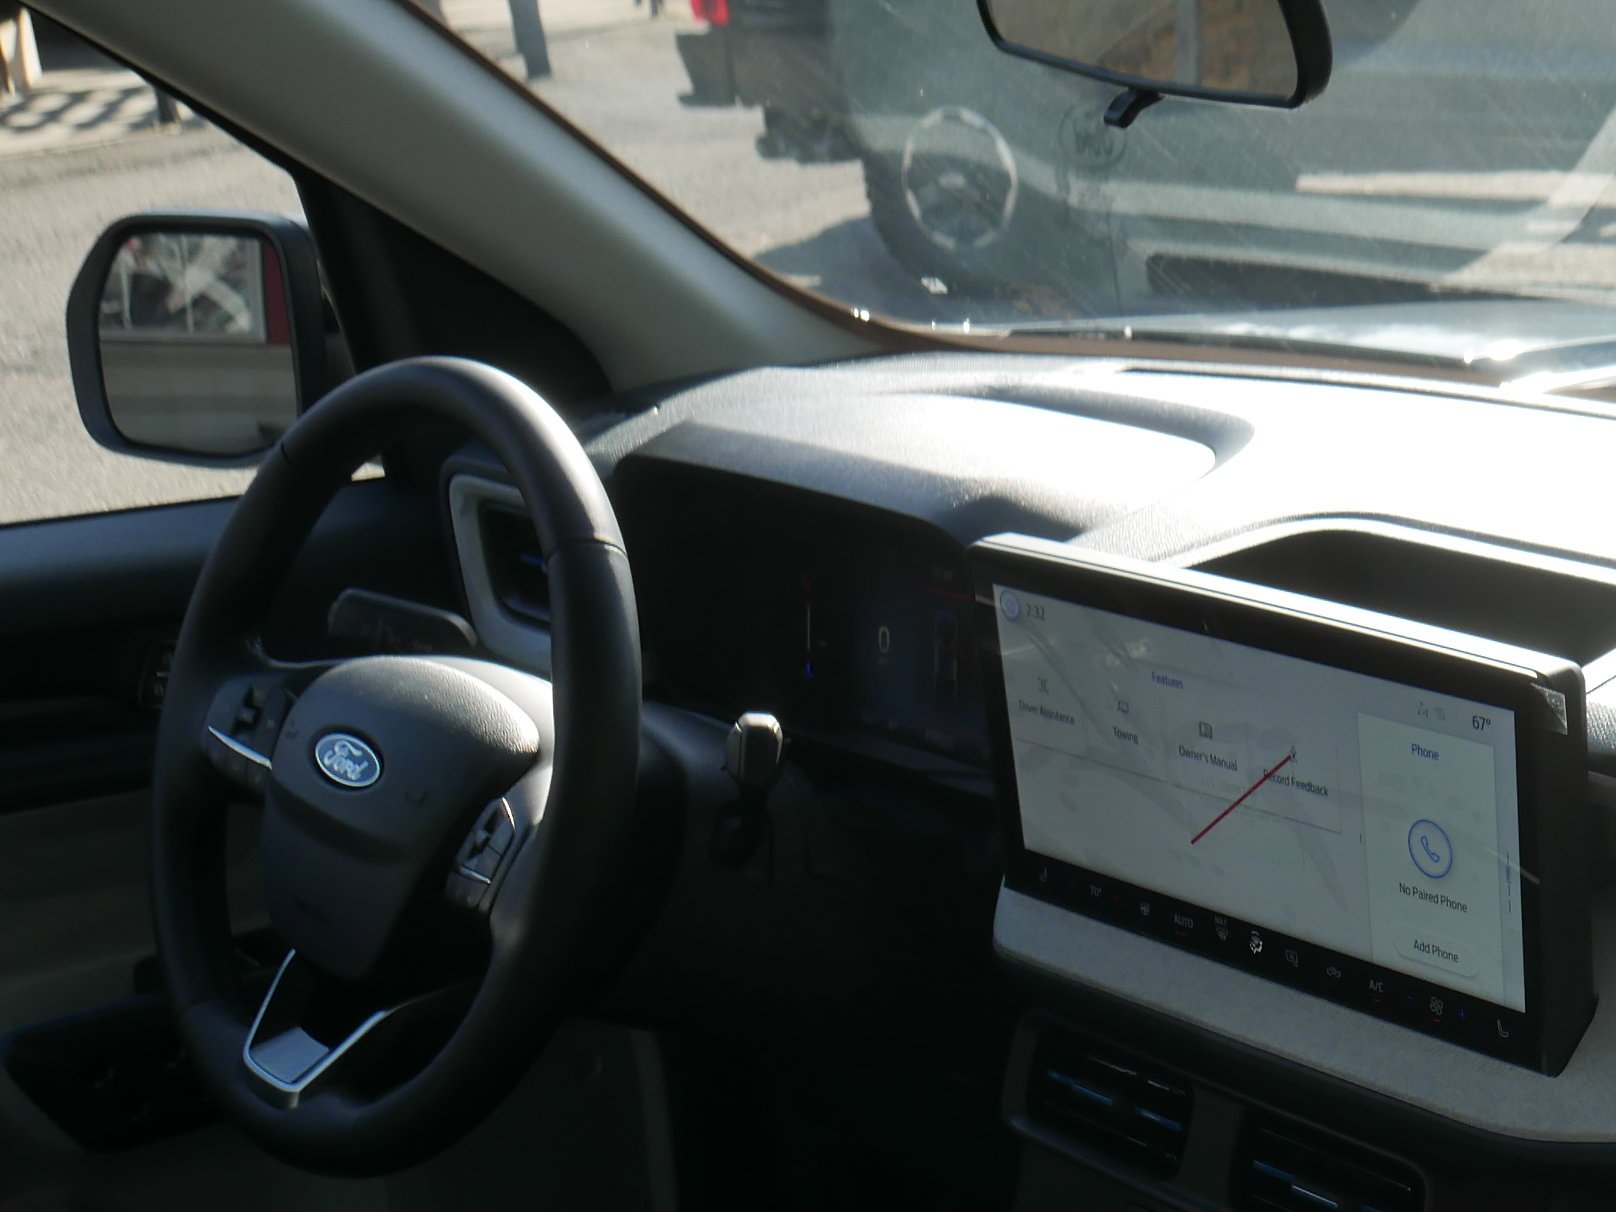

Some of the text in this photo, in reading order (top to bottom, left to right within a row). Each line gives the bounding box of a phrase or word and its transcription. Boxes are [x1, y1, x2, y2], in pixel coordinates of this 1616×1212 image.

[1151, 671, 1184, 690] Features
[1113, 726, 1139, 745] Towing
[323, 740, 369, 781] Ford
[1178, 745, 1238, 772] Owner's Manual
[1410, 743, 1440, 762] Phone
[1291, 776, 1329, 797] Feedback
[1399, 882, 1468, 914] No Paired Phone
[1173, 913, 1194, 929] AUTO
[1413, 939, 1459, 963] Add Phone
[1369, 977, 1384, 993] A/C
